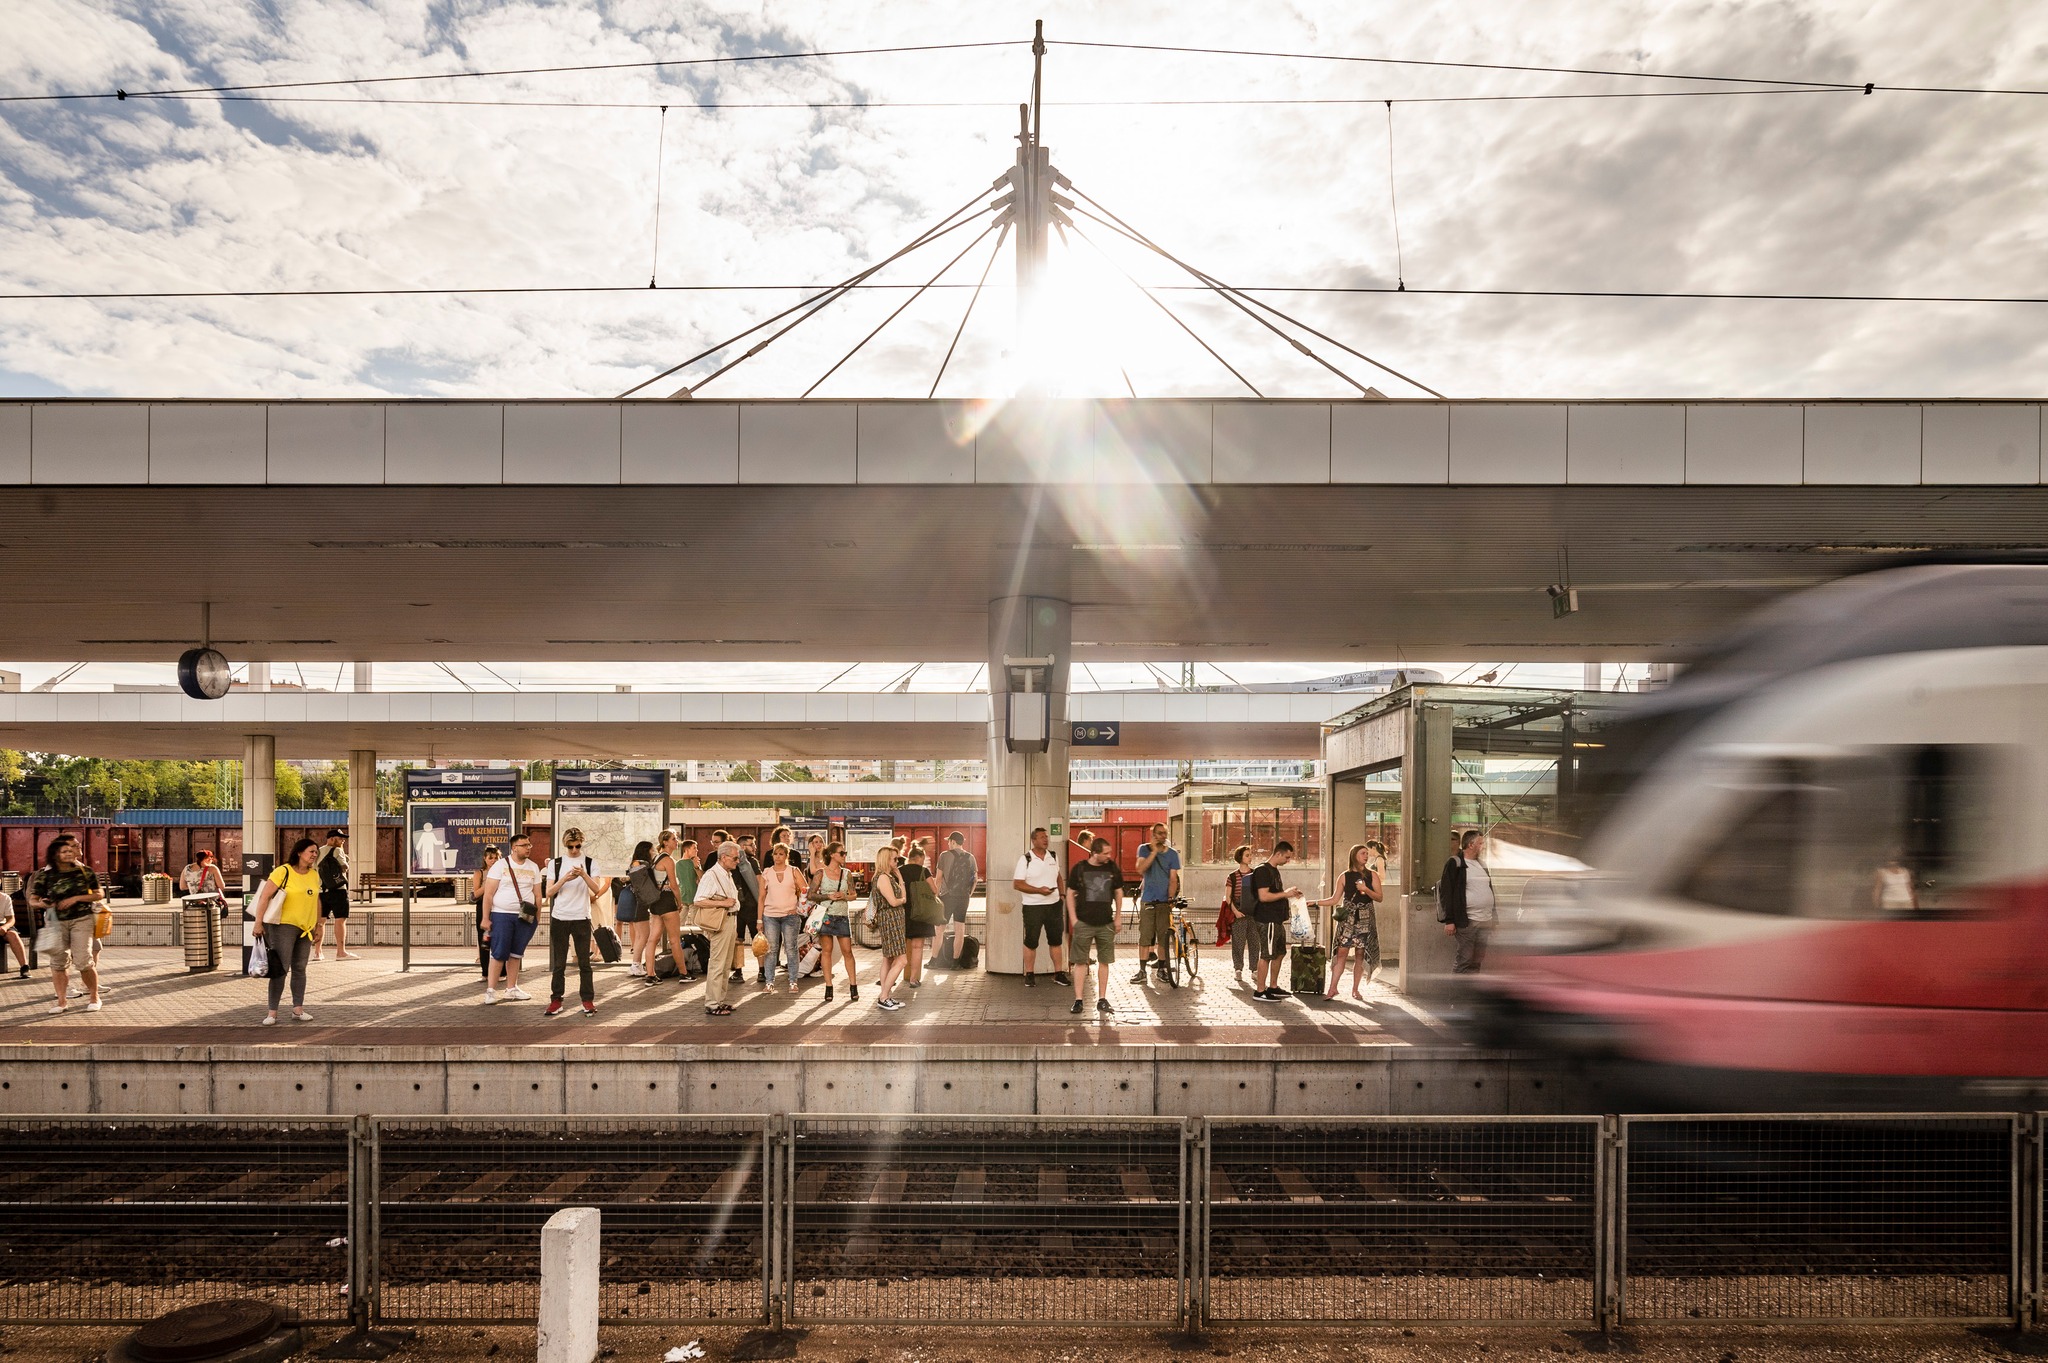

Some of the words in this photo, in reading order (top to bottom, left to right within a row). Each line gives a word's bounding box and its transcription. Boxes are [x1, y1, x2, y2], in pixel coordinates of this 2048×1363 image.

[447, 818, 484, 826] NYUGODTAN
[458, 827, 475, 835] CSAK
[476, 825, 508, 835] SZEMÉTTEL
[472, 836, 481, 844] NE
[482, 834, 508, 844] VÉTKEZZ!
